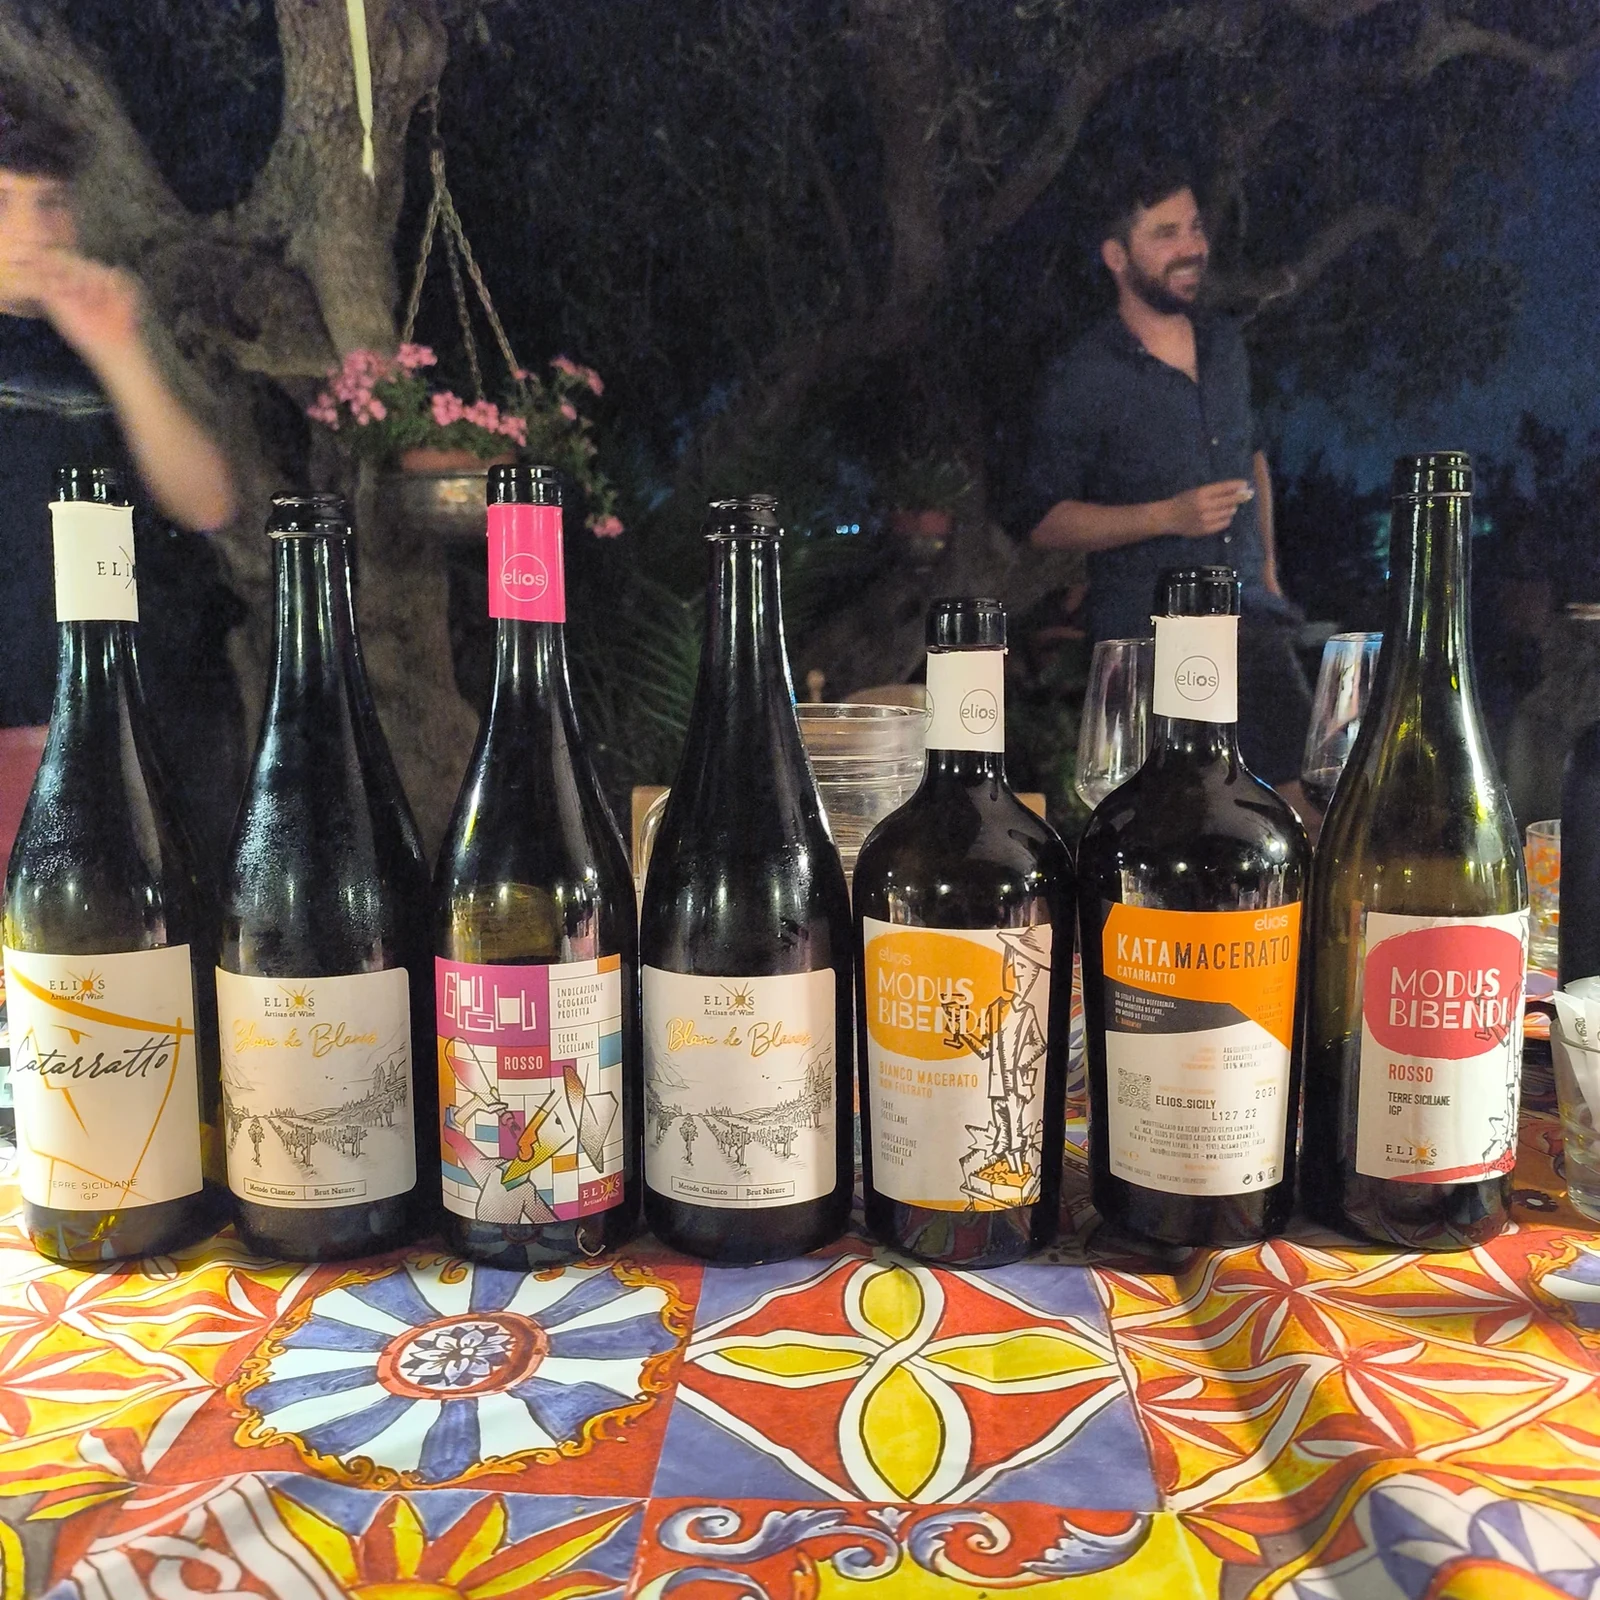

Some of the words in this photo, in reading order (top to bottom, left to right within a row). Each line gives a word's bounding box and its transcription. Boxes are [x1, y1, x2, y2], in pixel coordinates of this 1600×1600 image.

[502, 568, 546, 587] elios
[1176, 670, 1217, 687] elios
[961, 703, 996, 720] elios
[1254, 914, 1288, 931] elios
[1116, 965, 1176, 986] CATARRATTO
[1391, 966, 1501, 998] MODUS
[557, 982, 604, 998] INDICAZIONE
[878, 967, 975, 1006] MODUS
[557, 994, 597, 1009] GEOGRAFICA
[557, 1007, 590, 1019] PROTETTA
[703, 1008, 728, 1016] Artisan
[729, 1008, 736, 1016] of
[878, 996, 987, 1035] BIBENDI
[1389, 997, 1509, 1029] BIBENDI
[558, 1032, 578, 1043] TERRE
[723, 1026, 743, 1047] de
[558, 1040, 594, 1055] SICILIANE
[16, 1034, 179, 1079] Catarratto
[503, 1055, 544, 1072] ROSSO
[879, 1060, 913, 1082] BIANCO
[917, 1070, 978, 1088] MACERATO
[1388, 1063, 1434, 1083] ROSSO
[895, 1081, 933, 1099] FILTRATO
[1255, 1086, 1277, 1100] 2021
[1155, 1095, 1217, 1110] ELIOS_SICILY
[1388, 1091, 1413, 1105] TERRE
[1414, 1094, 1451, 1106] SICILIANE
[1211, 1110, 1239, 1121] L127
[1245, 1108, 1257, 1119] 22
[1388, 1105, 1402, 1116] IGP
[81, 1178, 138, 1191] SICILIANE
[701, 1186, 728, 1196] Classico
[746, 1188, 762, 1197] Brut
[80, 1192, 98, 1201] IGP
